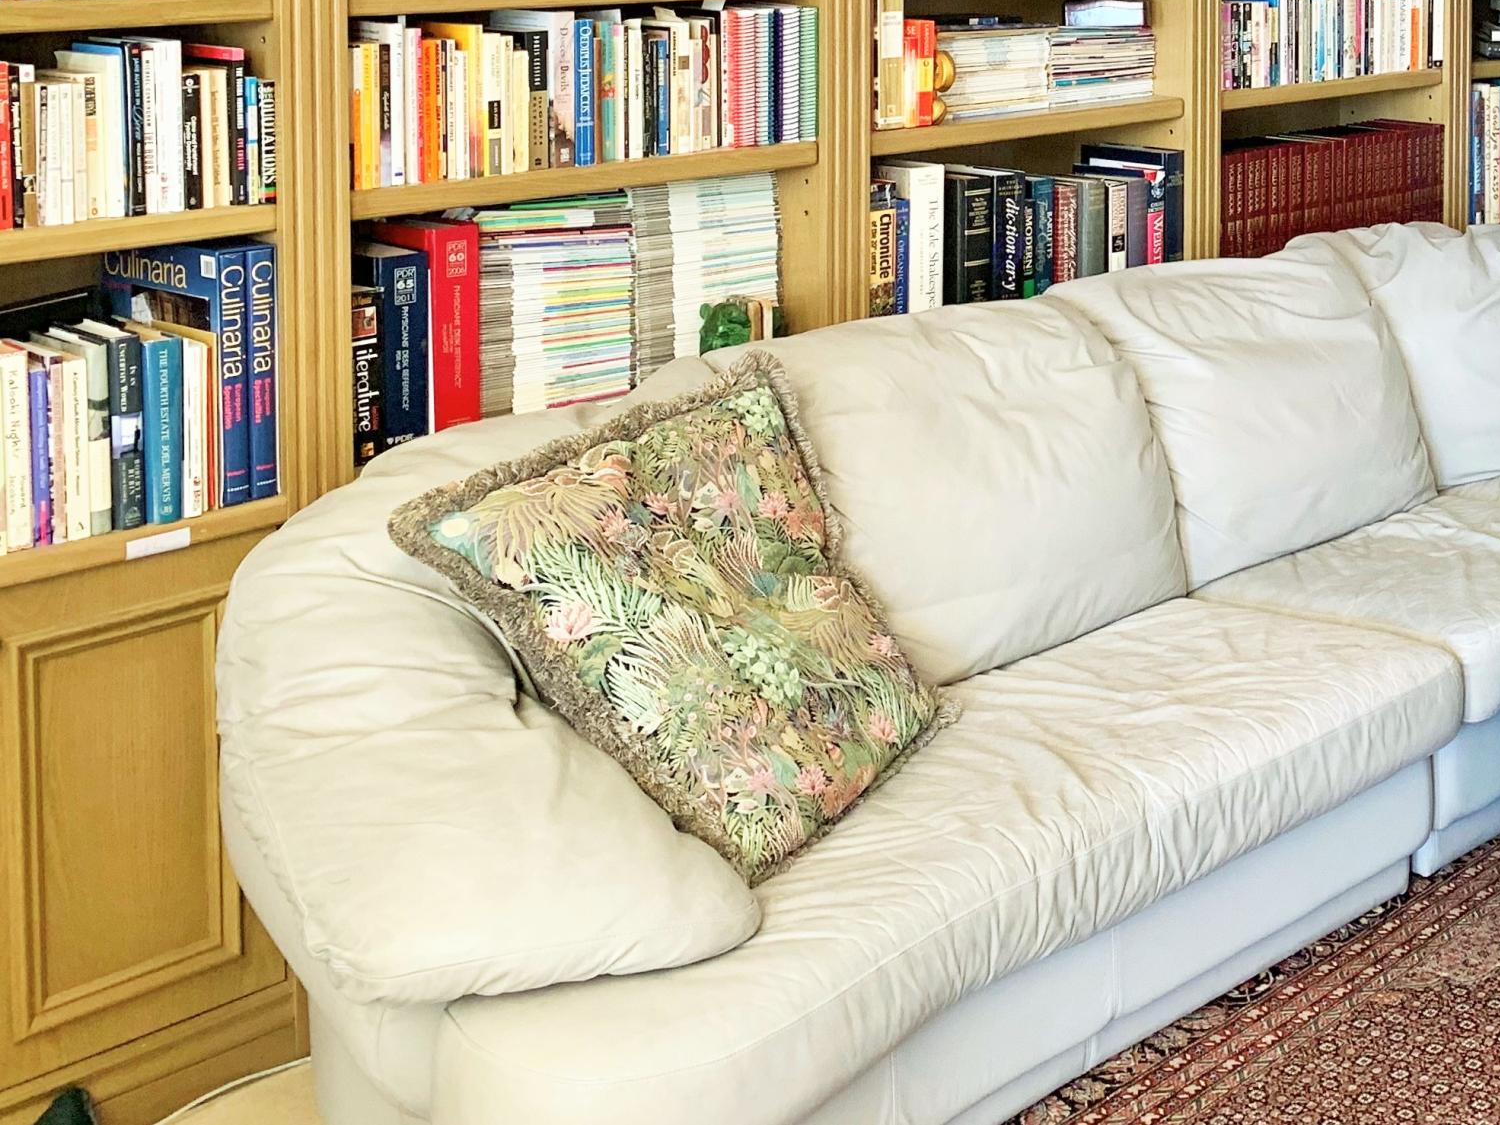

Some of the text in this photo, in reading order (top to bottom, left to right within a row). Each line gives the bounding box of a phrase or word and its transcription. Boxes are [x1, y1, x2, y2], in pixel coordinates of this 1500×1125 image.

[533, 35, 542, 87] DORIS LESSING
[578, 26, 592, 113] OEDIPUS JUDAICUS
[134, 97, 140, 105] IN
[145, 146, 153, 174] HOURS
[263, 99, 277, 184] QUOTATIONS
[879, 213, 892, 279] Chronicle
[927, 198, 938, 309] The Yale Shakespea
[1024, 215, 1033, 269] MODERN
[103, 252, 187, 289] Culinaria
[222, 265, 245, 379] Culinaria
[251, 260, 274, 373] Culinaria
[159, 349, 168, 367] THE
[401, 350, 410, 367] DESK
[120, 387, 129, 412] WORLD
[159, 369, 168, 405] FOURTH
[160, 407, 169, 440] ESTATE
